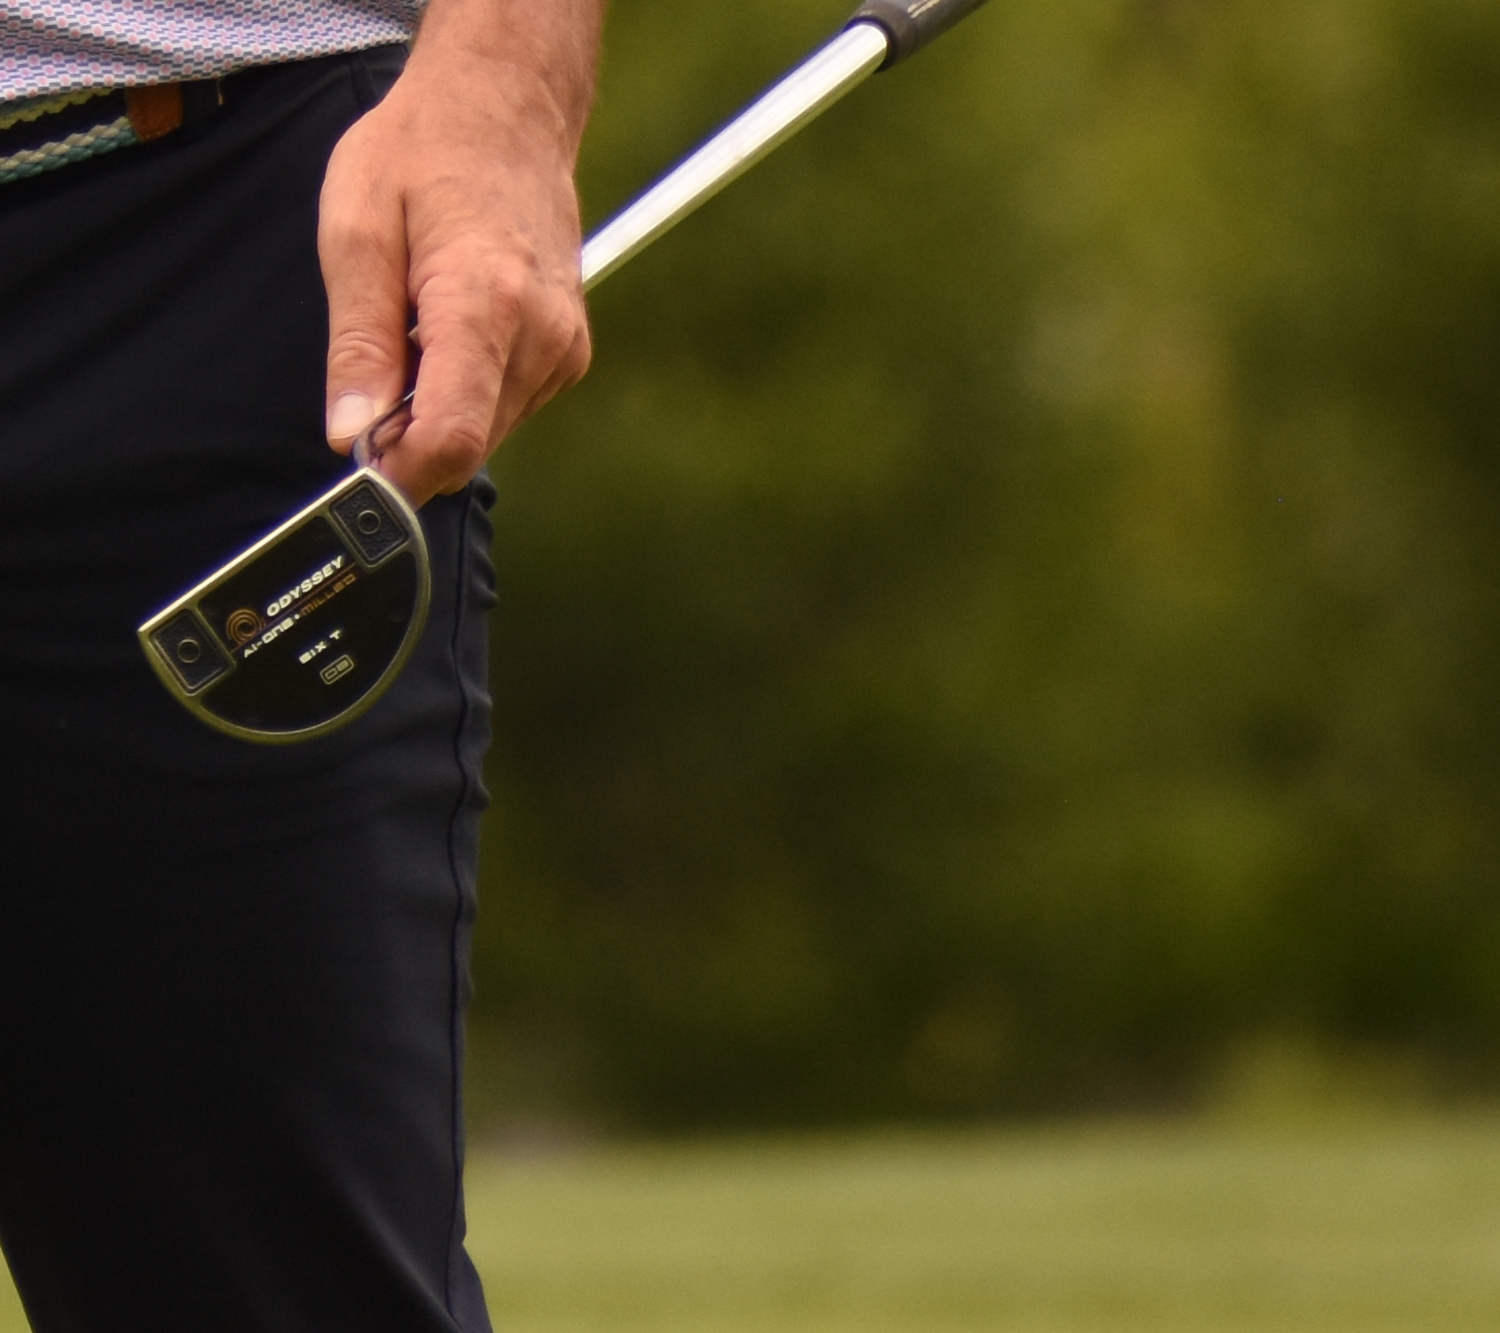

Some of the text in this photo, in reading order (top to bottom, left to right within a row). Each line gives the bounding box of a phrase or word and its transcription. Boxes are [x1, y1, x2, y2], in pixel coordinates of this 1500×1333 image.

[266, 555, 343, 617] ODYSSEY
[298, 630, 342, 665] SIX T
